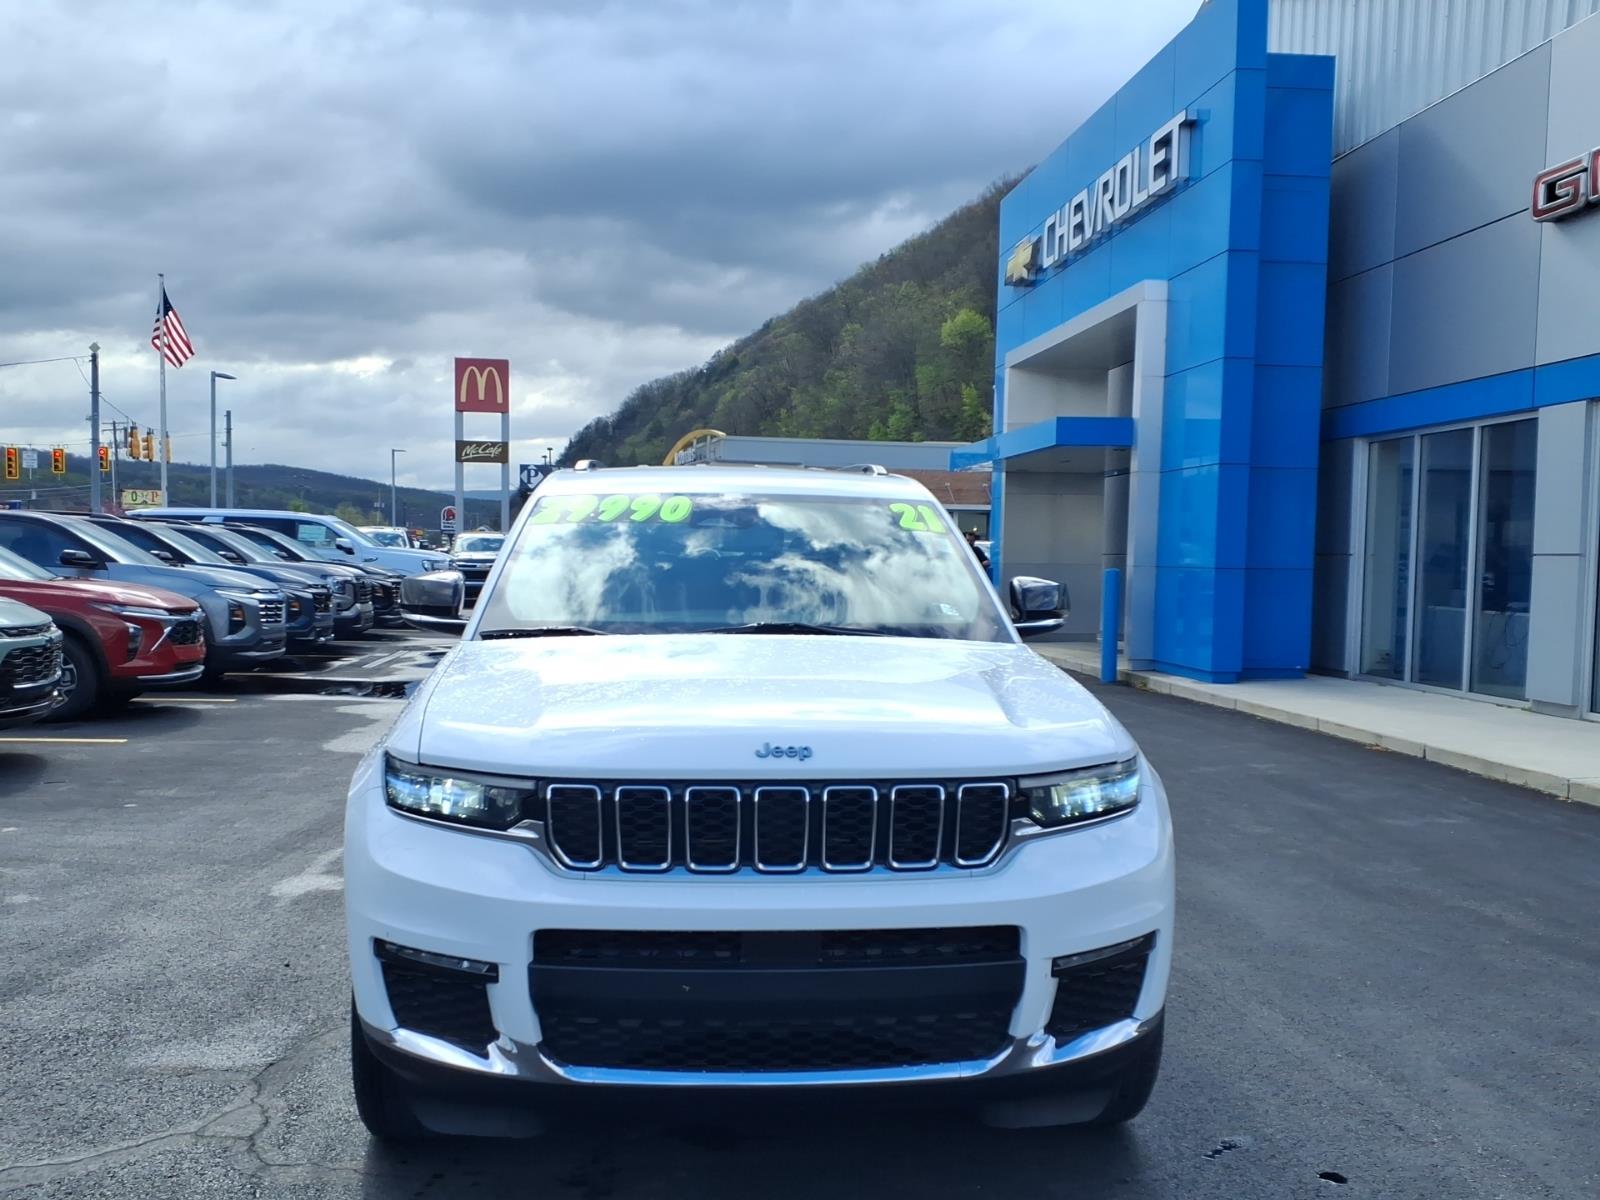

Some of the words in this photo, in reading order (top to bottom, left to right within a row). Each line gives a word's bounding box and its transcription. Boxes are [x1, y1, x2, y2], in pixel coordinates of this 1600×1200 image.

[1042, 109, 1188, 270] CHEVROLET
[1531, 146, 1600, 222] G
[889, 502, 946, 533] 21
[754, 742, 813, 762] Jeep
